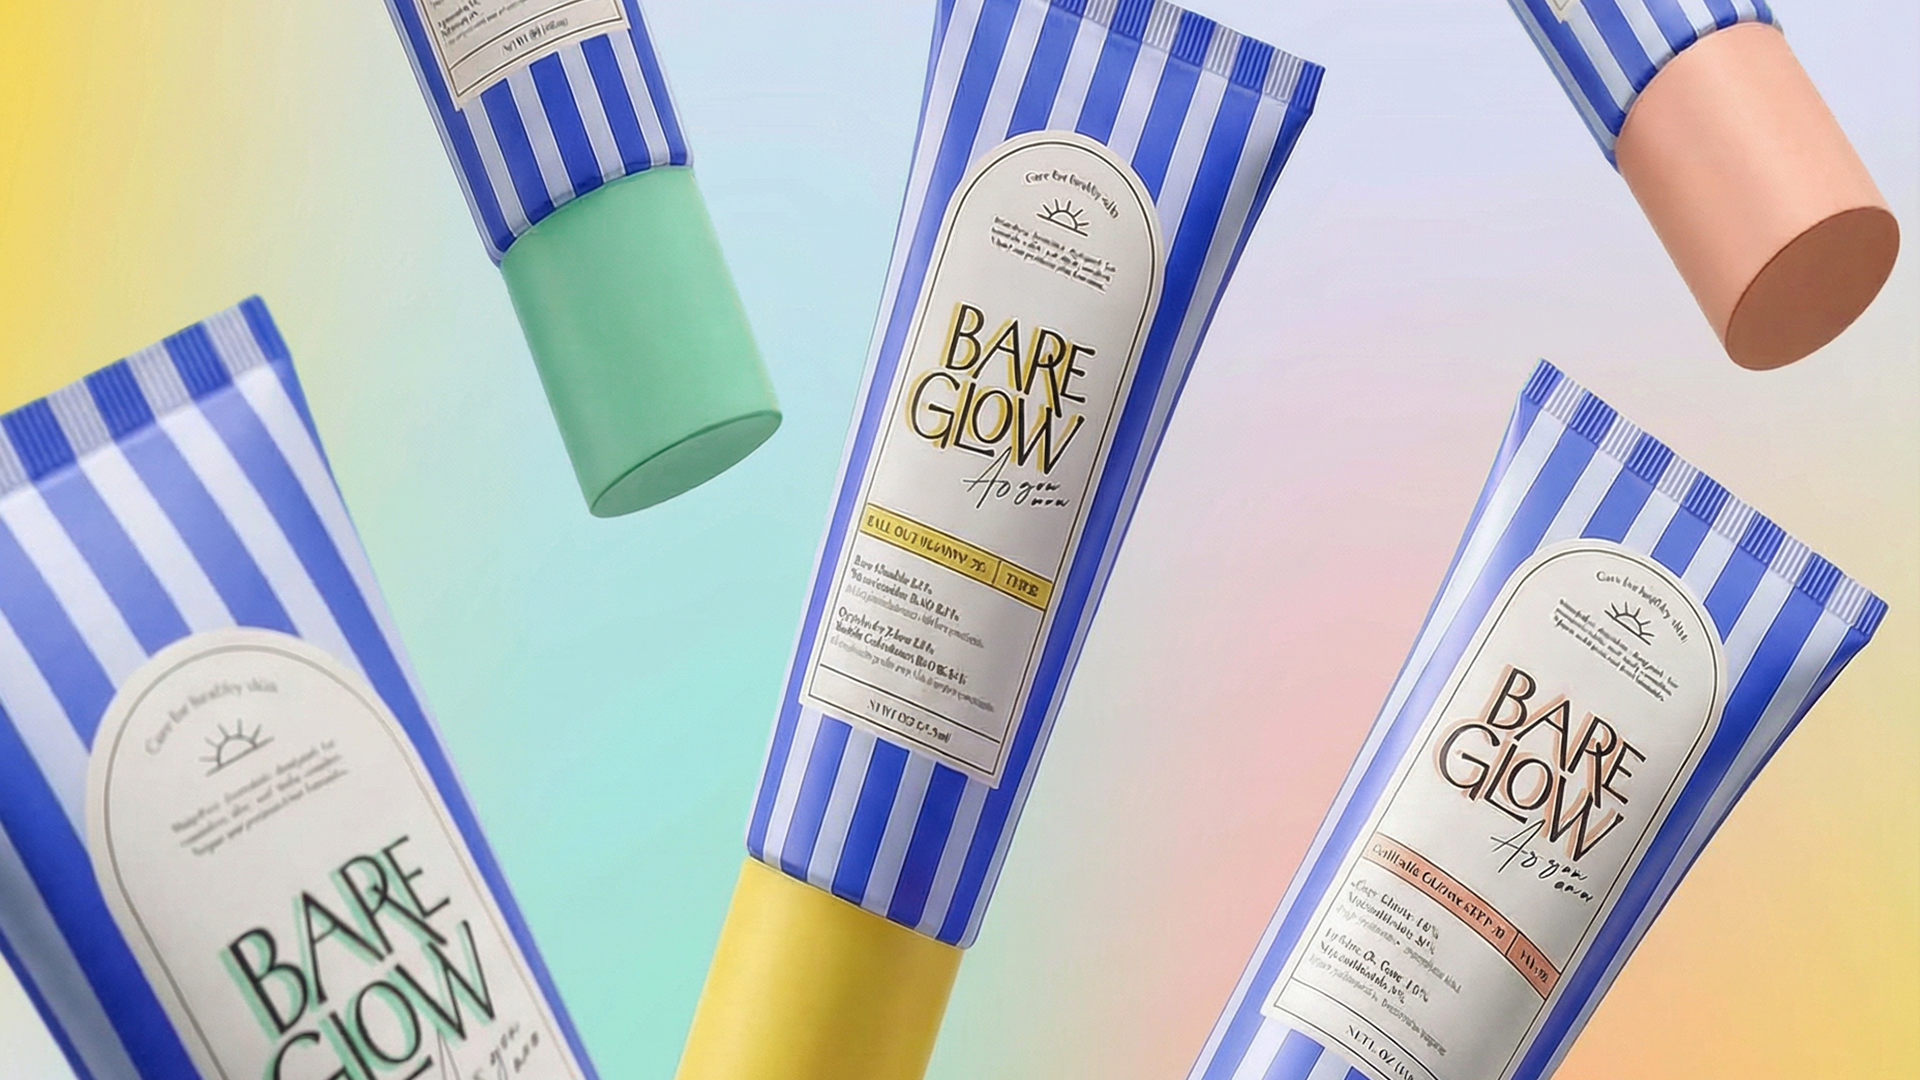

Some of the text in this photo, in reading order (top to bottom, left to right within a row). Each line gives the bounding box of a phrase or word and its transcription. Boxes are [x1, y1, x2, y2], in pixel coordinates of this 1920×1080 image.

[906, 371, 1086, 475] GLOW
[940, 302, 1096, 419] BARE
[1433, 719, 1626, 862] GLOW
[1479, 664, 1647, 809] BARE
[218, 835, 451, 1036] BARE
